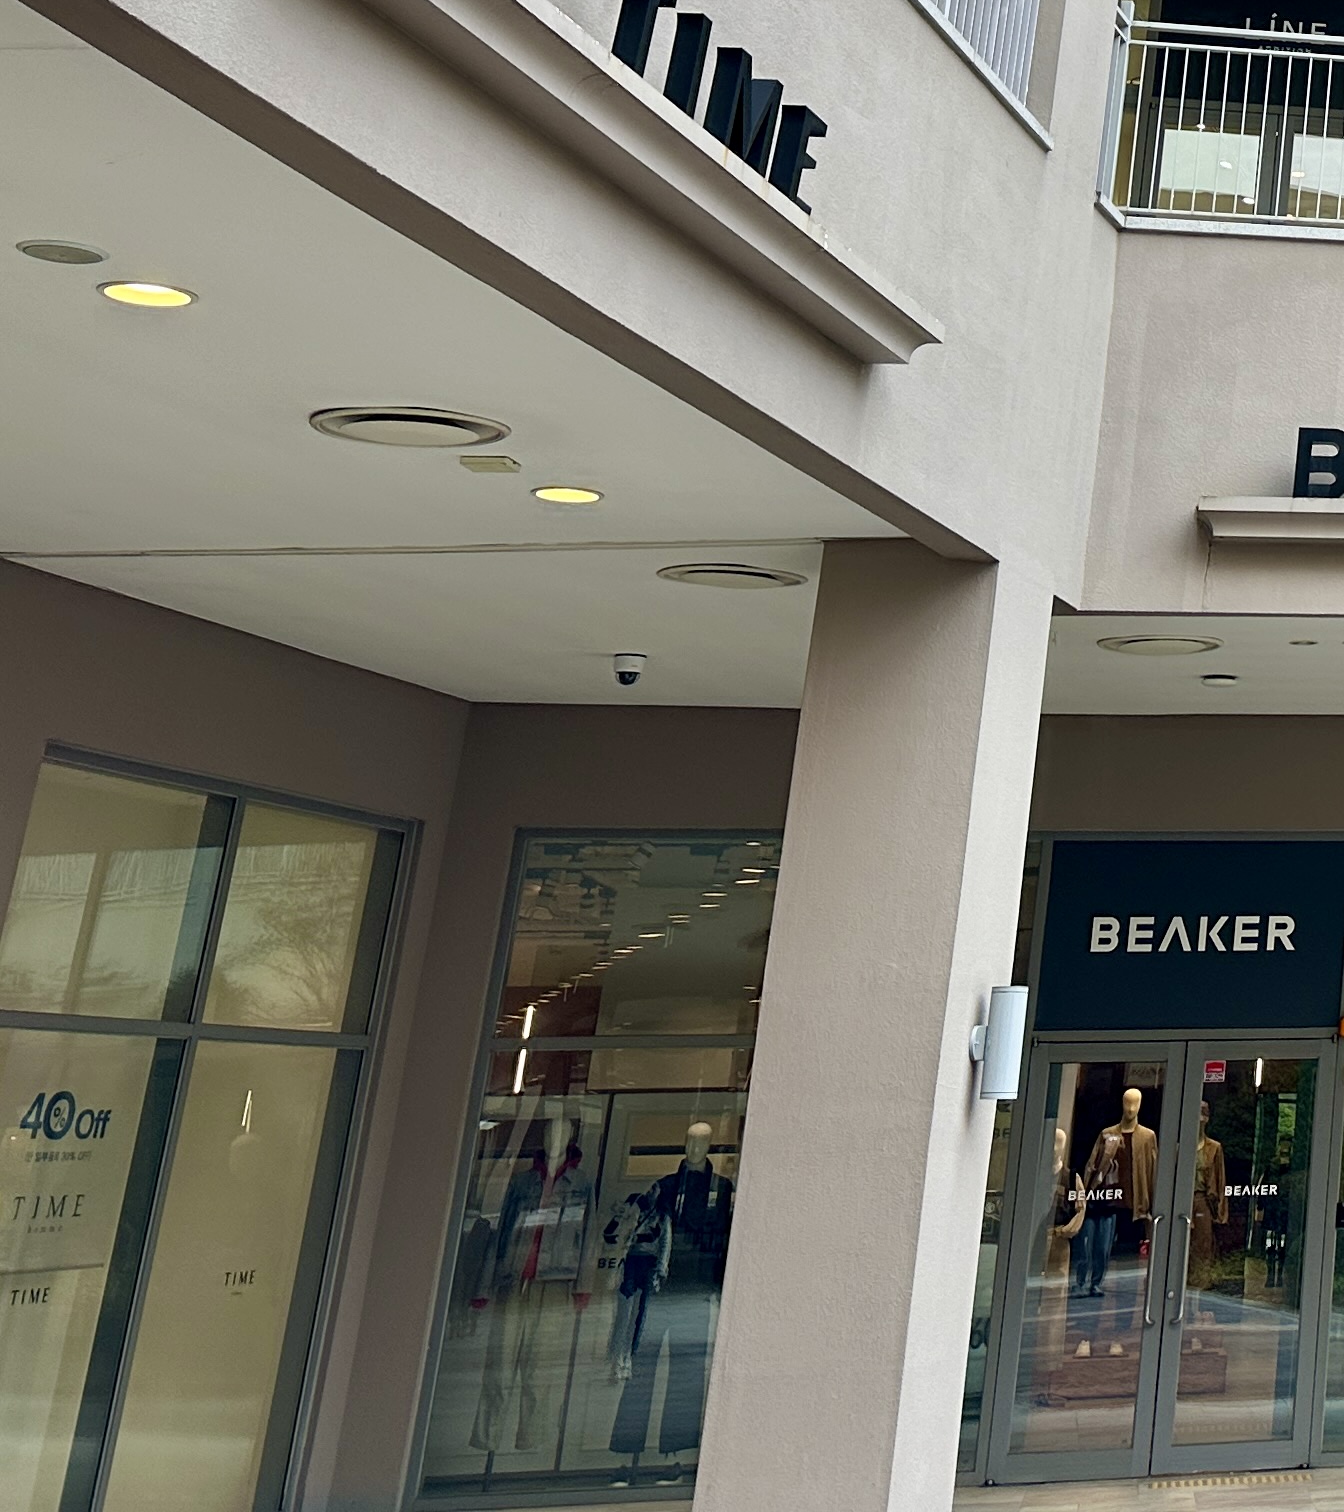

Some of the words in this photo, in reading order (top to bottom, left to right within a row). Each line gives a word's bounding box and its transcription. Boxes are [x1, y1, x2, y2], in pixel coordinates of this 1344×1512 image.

[1089, 914, 1297, 954] BEAKER
[1067, 1188, 1124, 1202] BEAKER
[1223, 1183, 1279, 1197] BEAKER
[12, 1194, 86, 1221] TIME
[224, 1269, 256, 1287] TIME
[10, 1286, 51, 1307] TIME
